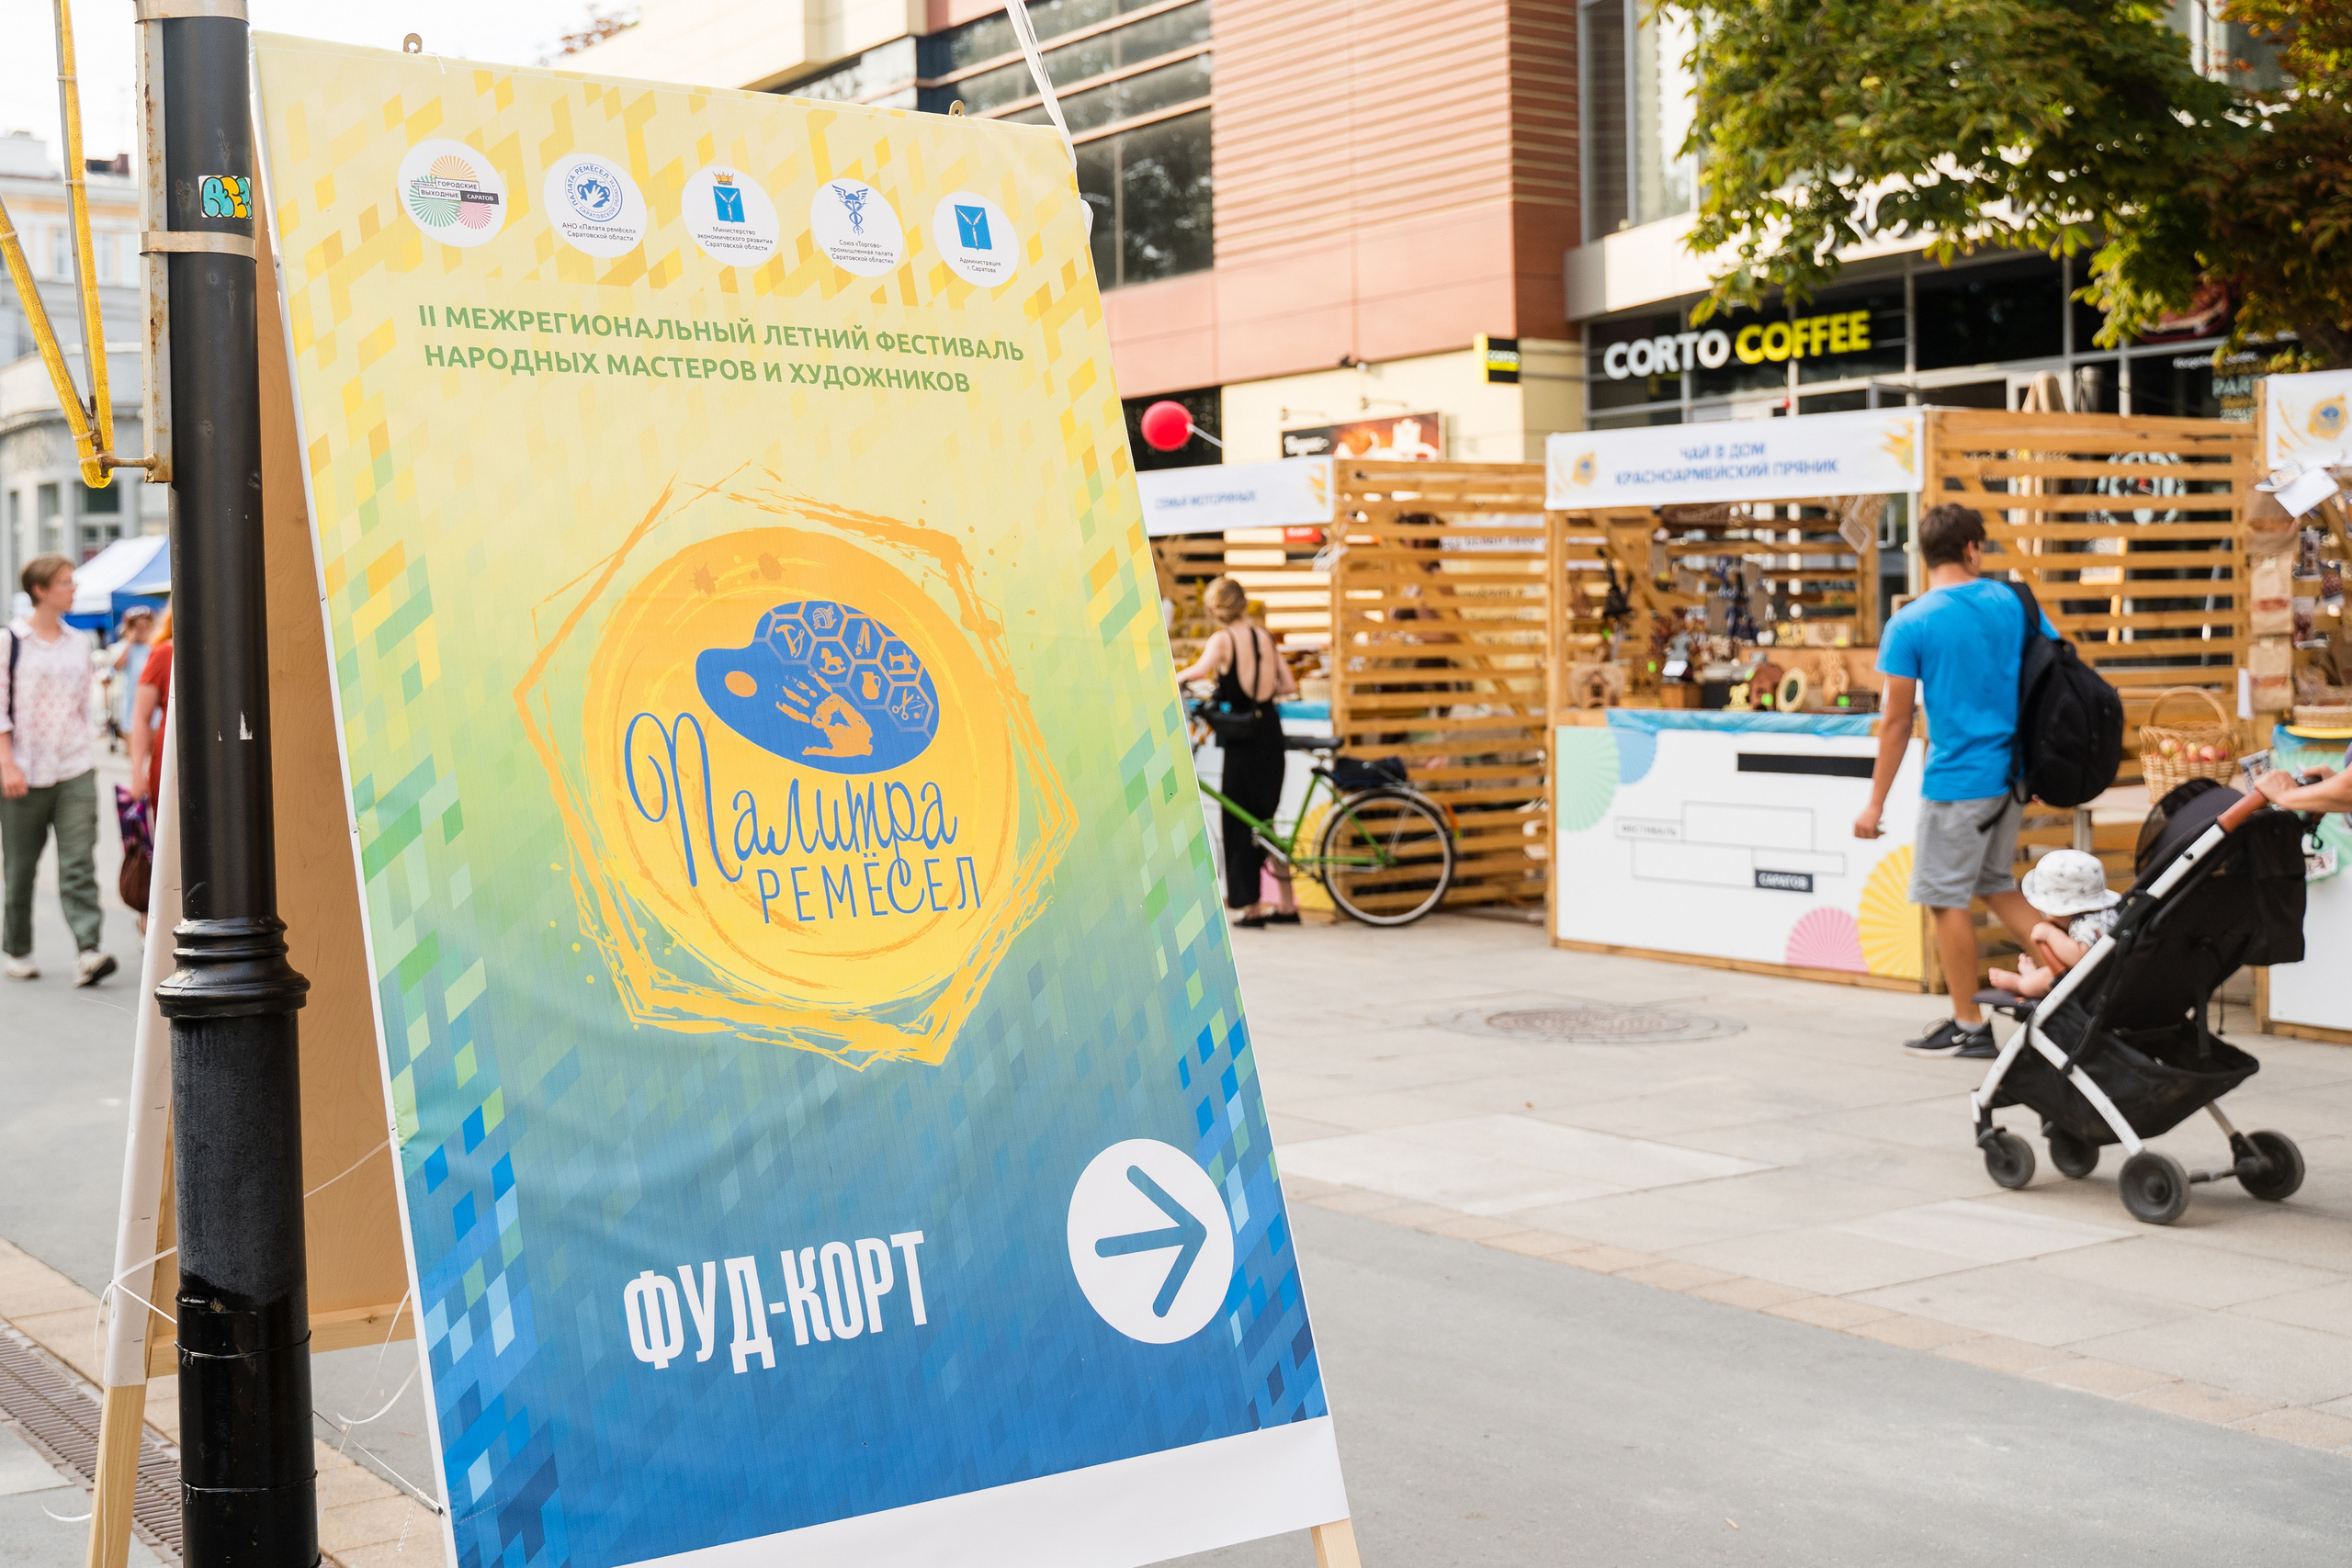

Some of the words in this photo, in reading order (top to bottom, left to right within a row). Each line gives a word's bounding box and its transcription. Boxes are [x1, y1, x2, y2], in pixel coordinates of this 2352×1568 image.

[437, 181, 478, 189] ГОРОДСКИЕ
[421, 189, 459, 198] ВЫХОДНЫЕ
[567, 175, 579, 207] ПАЛАТА
[579, 207, 616, 219] САРАТОВСКОЙ
[609, 179, 619, 207] ОБЛАСТИ
[579, 223, 605, 231] «Палата
[712, 226, 756, 235] Министерство
[567, 231, 607, 240] Саратовской
[608, 233, 634, 242] области
[696, 233, 745, 243] экономического
[705, 240, 744, 249] Саратовской
[830, 247, 874, 255] промышленная
[831, 254, 868, 262] Саратовской
[868, 256, 894, 265] области»
[959, 257, 1001, 266] Администрация
[971, 265, 996, 274] Саратова
[446, 306, 756, 344] МЕЖРЕГИОНАЛЬНЫЙ
[763, 324, 869, 351] ЛЕТНИЙ
[876, 331, 1024, 361] ФЕСТИВАЛЬ
[1603, 329, 1731, 380] CORTO
[1735, 310, 1871, 364] COFFEE
[424, 344, 600, 377] НАРОДНЫХ
[606, 354, 757, 381] МАСТЕРОВ
[763, 362, 782, 382] И
[790, 363, 970, 393] ХУДОЖНИКОВ
[1680, 446, 1710, 460] ЧАЙ
[1715, 445, 1723, 458] В
[1729, 443, 1765, 459] ДОМ
[1615, 462, 1769, 485] КРАСНОАРМЕЙСКИЙ
[1772, 459, 1839, 478] ПРЯНИК
[624, 712, 957, 888] Палитра
[756, 852, 982, 924] РЕМЁСЕЛ
[623, 1230, 927, 1374] ФУД-КОРТ
